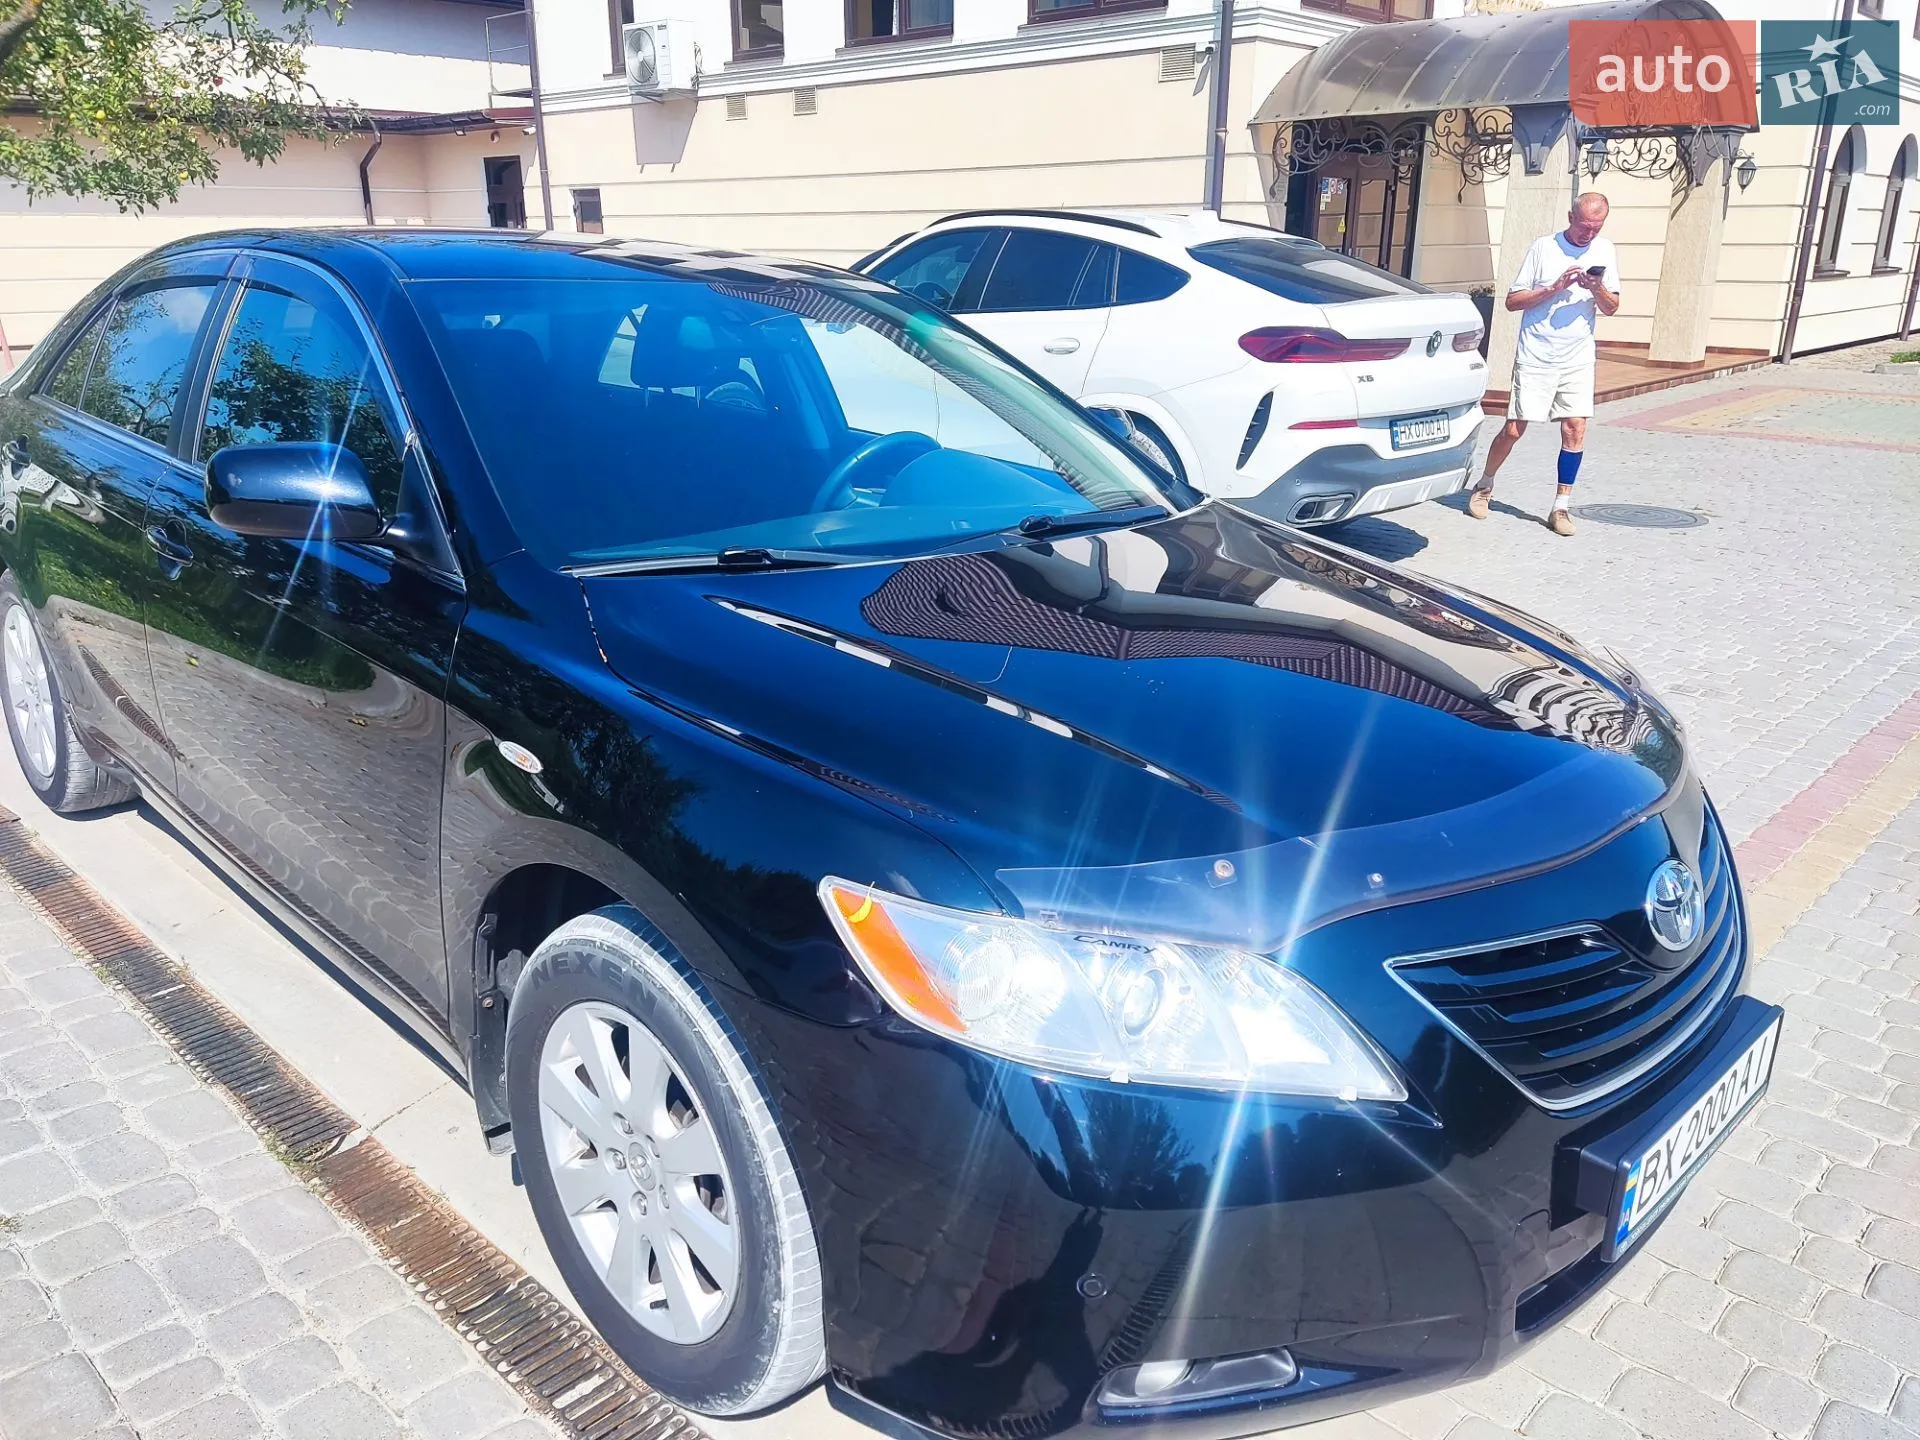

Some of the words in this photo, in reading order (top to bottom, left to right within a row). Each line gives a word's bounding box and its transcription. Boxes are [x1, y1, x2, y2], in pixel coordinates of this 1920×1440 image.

[1073, 935, 1157, 954] CAMRY
[530, 951, 659, 1017] NEXEN
[1636, 1126, 1683, 1214] BX
[1680, 1069, 1738, 1169] 2000
